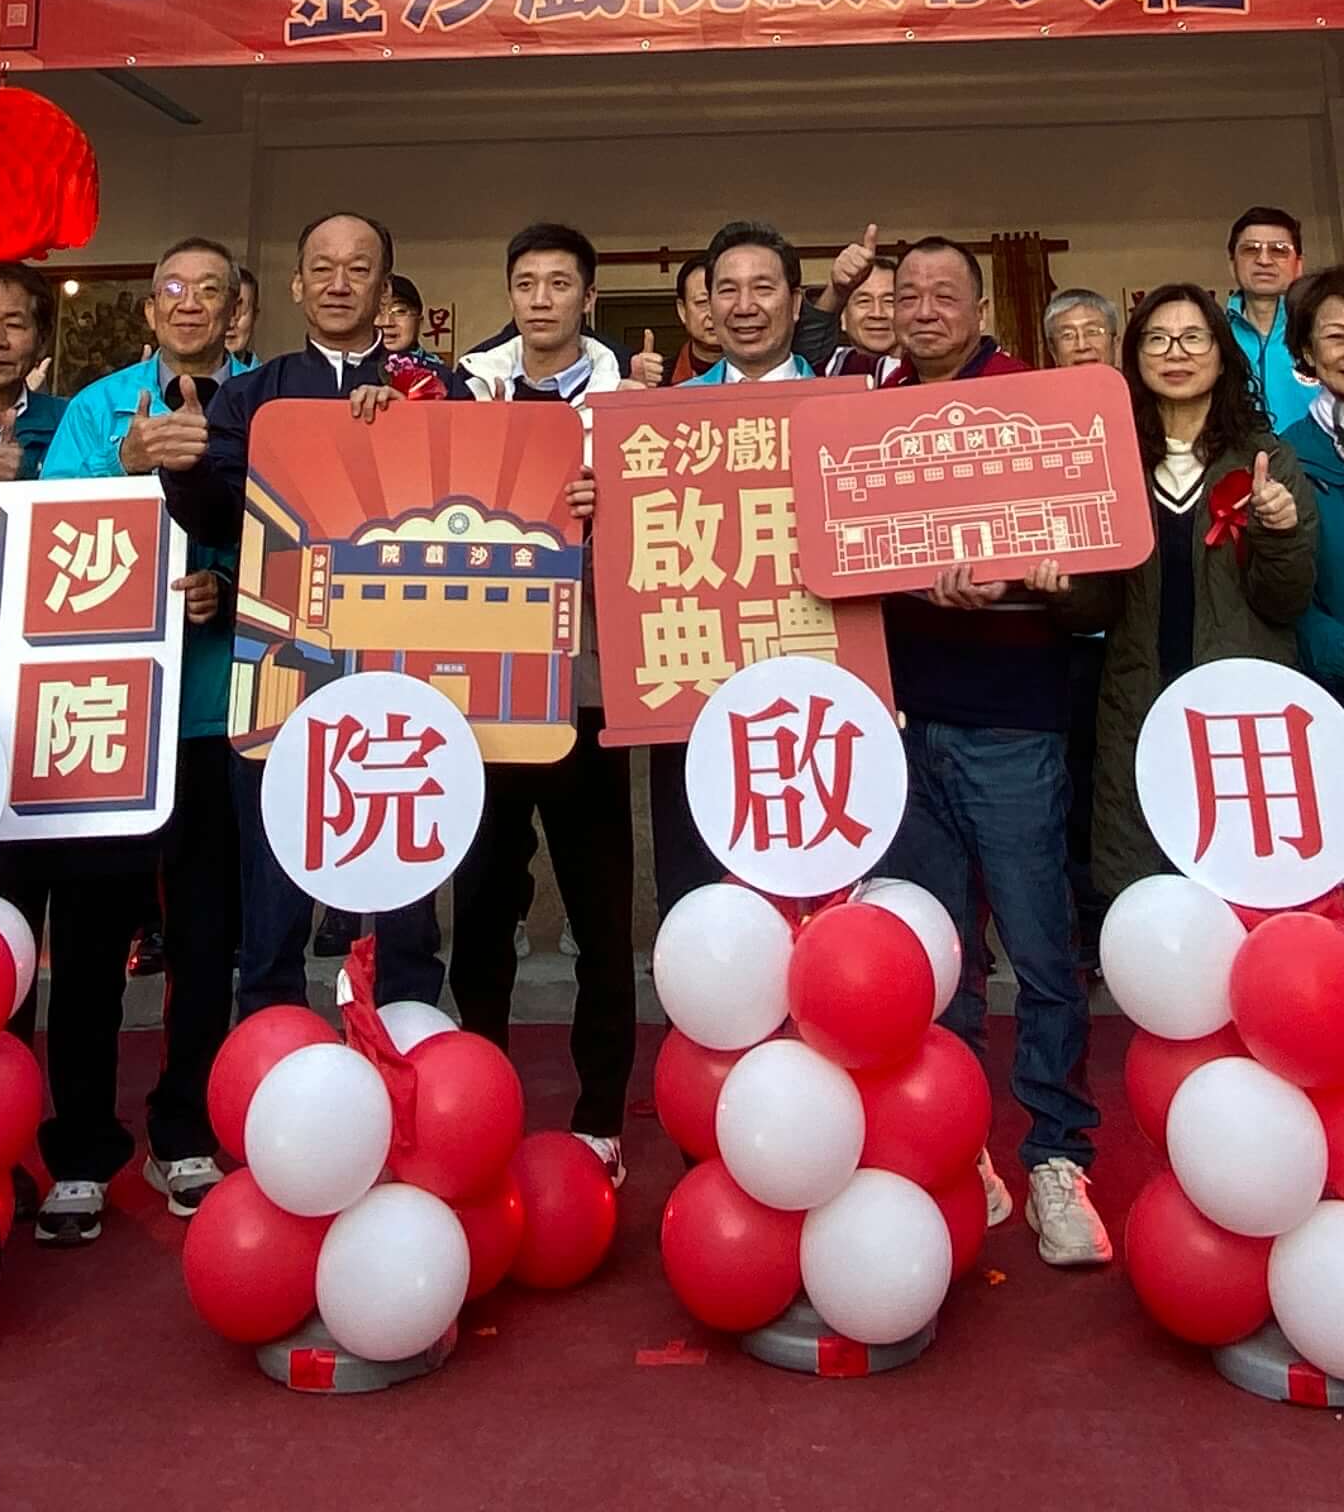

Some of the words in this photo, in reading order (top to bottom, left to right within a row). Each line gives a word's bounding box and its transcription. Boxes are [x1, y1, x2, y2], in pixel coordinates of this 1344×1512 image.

[32, 676, 129, 779] 院
[304, 712, 448, 871] 院
[728, 695, 872, 853] 啟
[1183, 703, 1324, 864] 用
